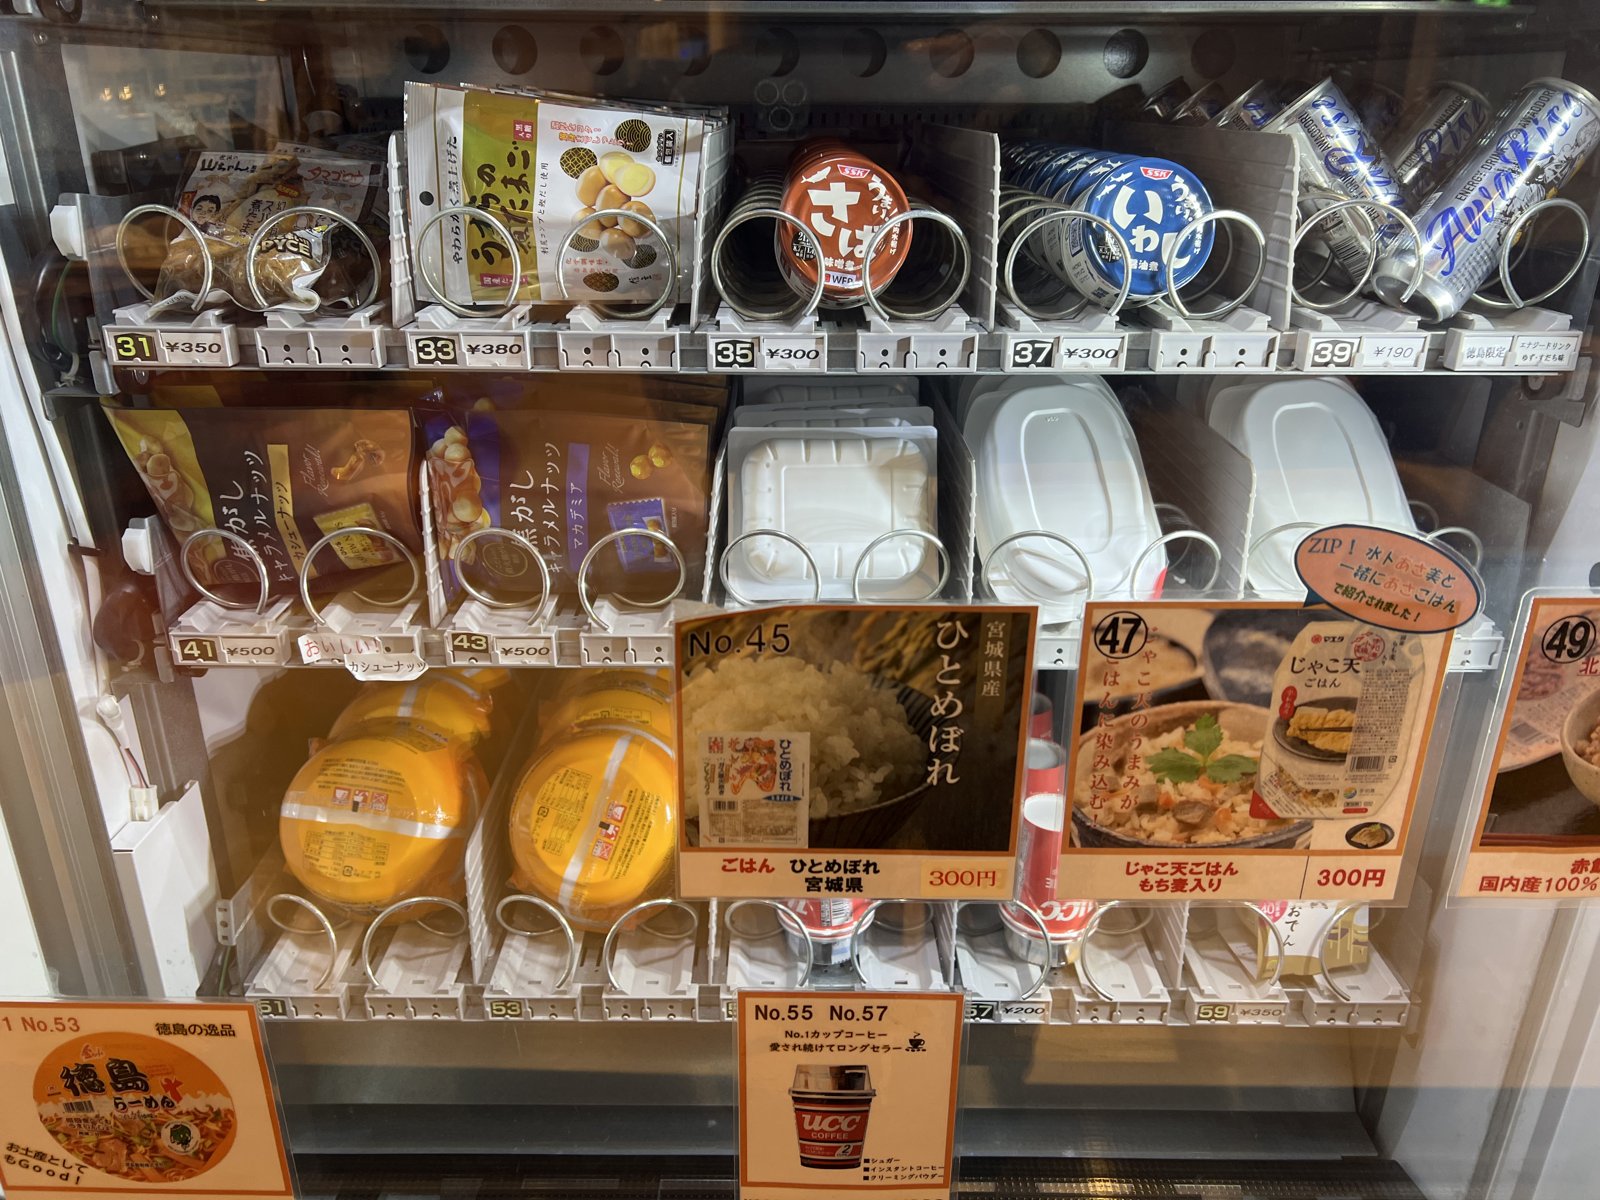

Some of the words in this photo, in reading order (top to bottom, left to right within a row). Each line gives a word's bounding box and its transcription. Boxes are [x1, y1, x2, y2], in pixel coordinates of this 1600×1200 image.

[843, 166, 867, 178] SSK
[1145, 169, 1168, 178] SSK
[807, 181, 882, 258] さば
[1113, 184, 1191, 269] いわし
[256, 239, 312, 258] PYCE
[116, 336, 151, 358] 31
[165, 342, 222, 354] ¥350
[417, 339, 456, 361] 33
[466, 343, 523, 355] ¥380
[716, 343, 754, 363] 35
[766, 347, 820, 360] ¥300
[1014, 343, 1053, 363] 37
[1064, 348, 1119, 360] ¥300
[1314, 342, 1352, 363] 39
[1373, 346, 1414, 358] ¥190
[1519, 341, 1571, 351] エナジードリンク
[243, 449, 293, 583] キャラメルナッツ
[540, 442, 564, 574] キャラメルナッツ
[569, 482, 585, 549] マカデミア
[274, 481, 306, 560] カシューナッツ
[1334, 582, 1422, 622] で紹介されました!
[453, 634, 488, 651] 43
[688, 624, 791, 656] No.45
[1098, 616, 1142, 655] 47
[1545, 619, 1591, 660] 49
[183, 640, 215, 659] 41
[227, 646, 275, 656] ¥500
[304, 639, 381, 657] おいしい!
[501, 646, 550, 657] ¥500
[981, 620, 1006, 697] 宮城県産
[1290, 656, 1361, 674] じゃこ天
[1304, 677, 1342, 689] ごはん
[926, 620, 969, 786] ひとめぼれ
[1120, 626, 1158, 810] じゃこ天のうまみが
[779, 739, 793, 791] ひとめぼれ
[721, 857, 775, 873] ごはん
[790, 859, 880, 875] ひとめぼれ
[1124, 862, 1239, 877] じゃこ天ごはん
[804, 877, 864, 892] 宮城県
[929, 871, 996, 886] 300円
[1138, 878, 1222, 893] もち麦入り
[1317, 868, 1386, 888] 300円
[1478, 875, 1600, 894] 国内産100%
[1283, 905, 1302, 947] おでん
[492, 1001, 521, 1016] 53
[754, 1004, 814, 1021] No.55
[829, 1005, 889, 1022] No.57
[1003, 1006, 1045, 1016] ¥200
[1199, 1005, 1229, 1018] 59
[1240, 1008, 1281, 1017] ¥350
[21, 1016, 80, 1033] No.53
[155, 1023, 236, 1037] 徳島の逸品
[784, 1029, 888, 1039] No.1カップコーヒー
[769, 1042, 902, 1053] 愛され続けてロングセラー
[60, 1057, 150, 1097] 徳島
[113, 1096, 177, 1112] らーめん
[801, 1112, 862, 1132] UCC
[810, 1131, 849, 1140] COFFEE
[6, 1142, 89, 1175] お土産として
[841, 1144, 852, 1155] 2
[870, 1165, 945, 1173] インスタントコーヒー
[870, 1173, 944, 1181] クリーミングパウダー
